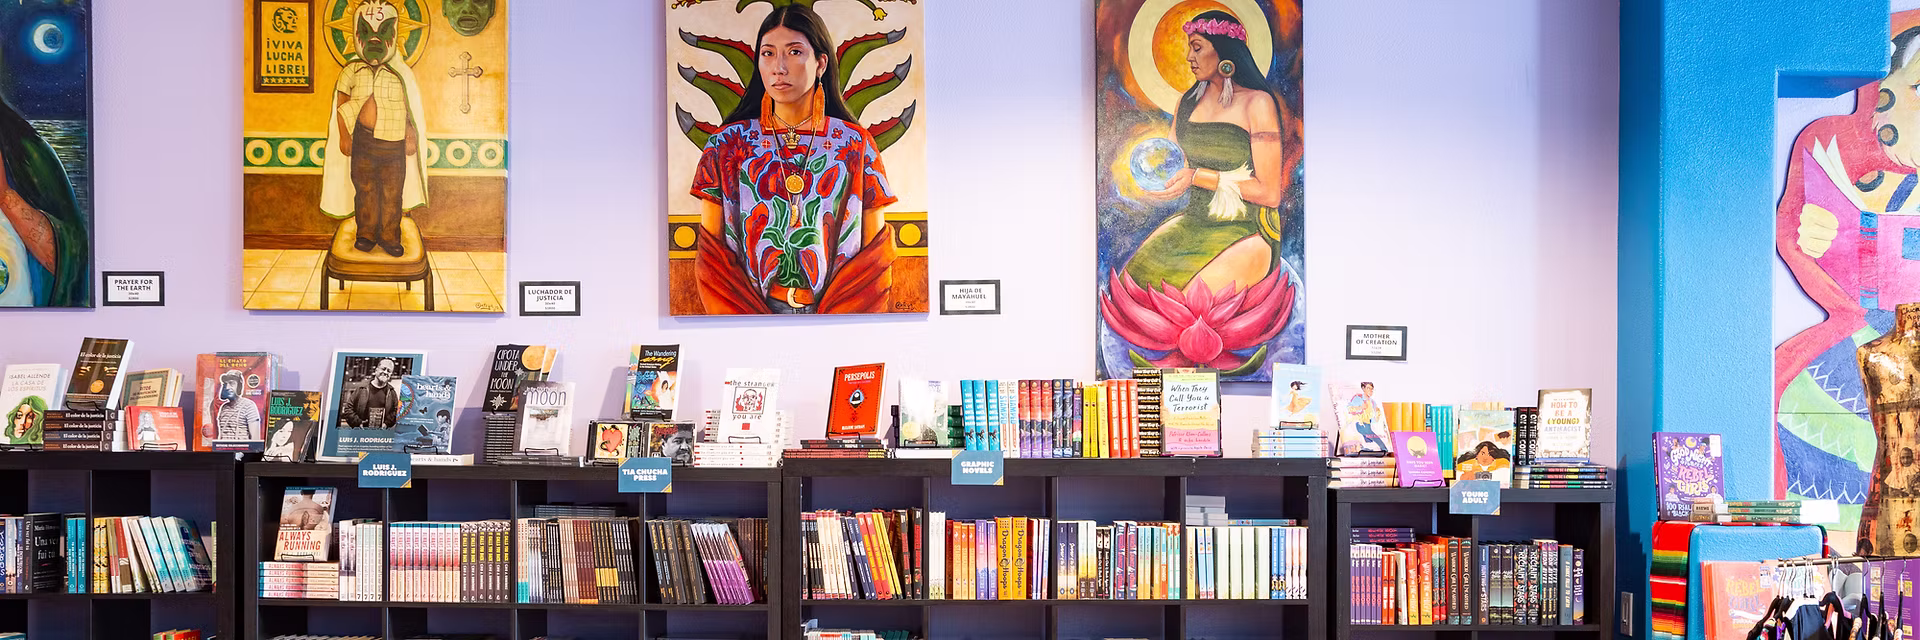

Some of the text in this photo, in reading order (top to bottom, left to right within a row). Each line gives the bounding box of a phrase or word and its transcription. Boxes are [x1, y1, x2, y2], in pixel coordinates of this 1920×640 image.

[365, 6, 384, 21] 43
[267, 52, 302, 61] LUCHA
[266, 64, 305, 75] LIBRE!
[497, 349, 520, 360] CIPOTA
[494, 361, 519, 371] UNDER
[844, 371, 875, 382] PERSEPOLIS
[490, 378, 514, 390] MOON
[527, 390, 566, 405] moon
[270, 406, 303, 416] RODRIGUEZ
[1173, 404, 1208, 412] Terrorist
[1520, 414, 1527, 424] ON
[1530, 414, 1536, 424] ON
[1678, 465, 1714, 481] REBEL
[1677, 480, 1710, 496] GIRLS
[1666, 502, 1676, 510] 100
[34, 536, 48, 546] Una
[279, 532, 311, 541] ALWAYS
[284, 541, 321, 551] RUNNING
[38, 550, 47, 560] fui
[1015, 530, 1024, 588] Dragon Hoops
[1000, 568, 1009, 589] Hoops
